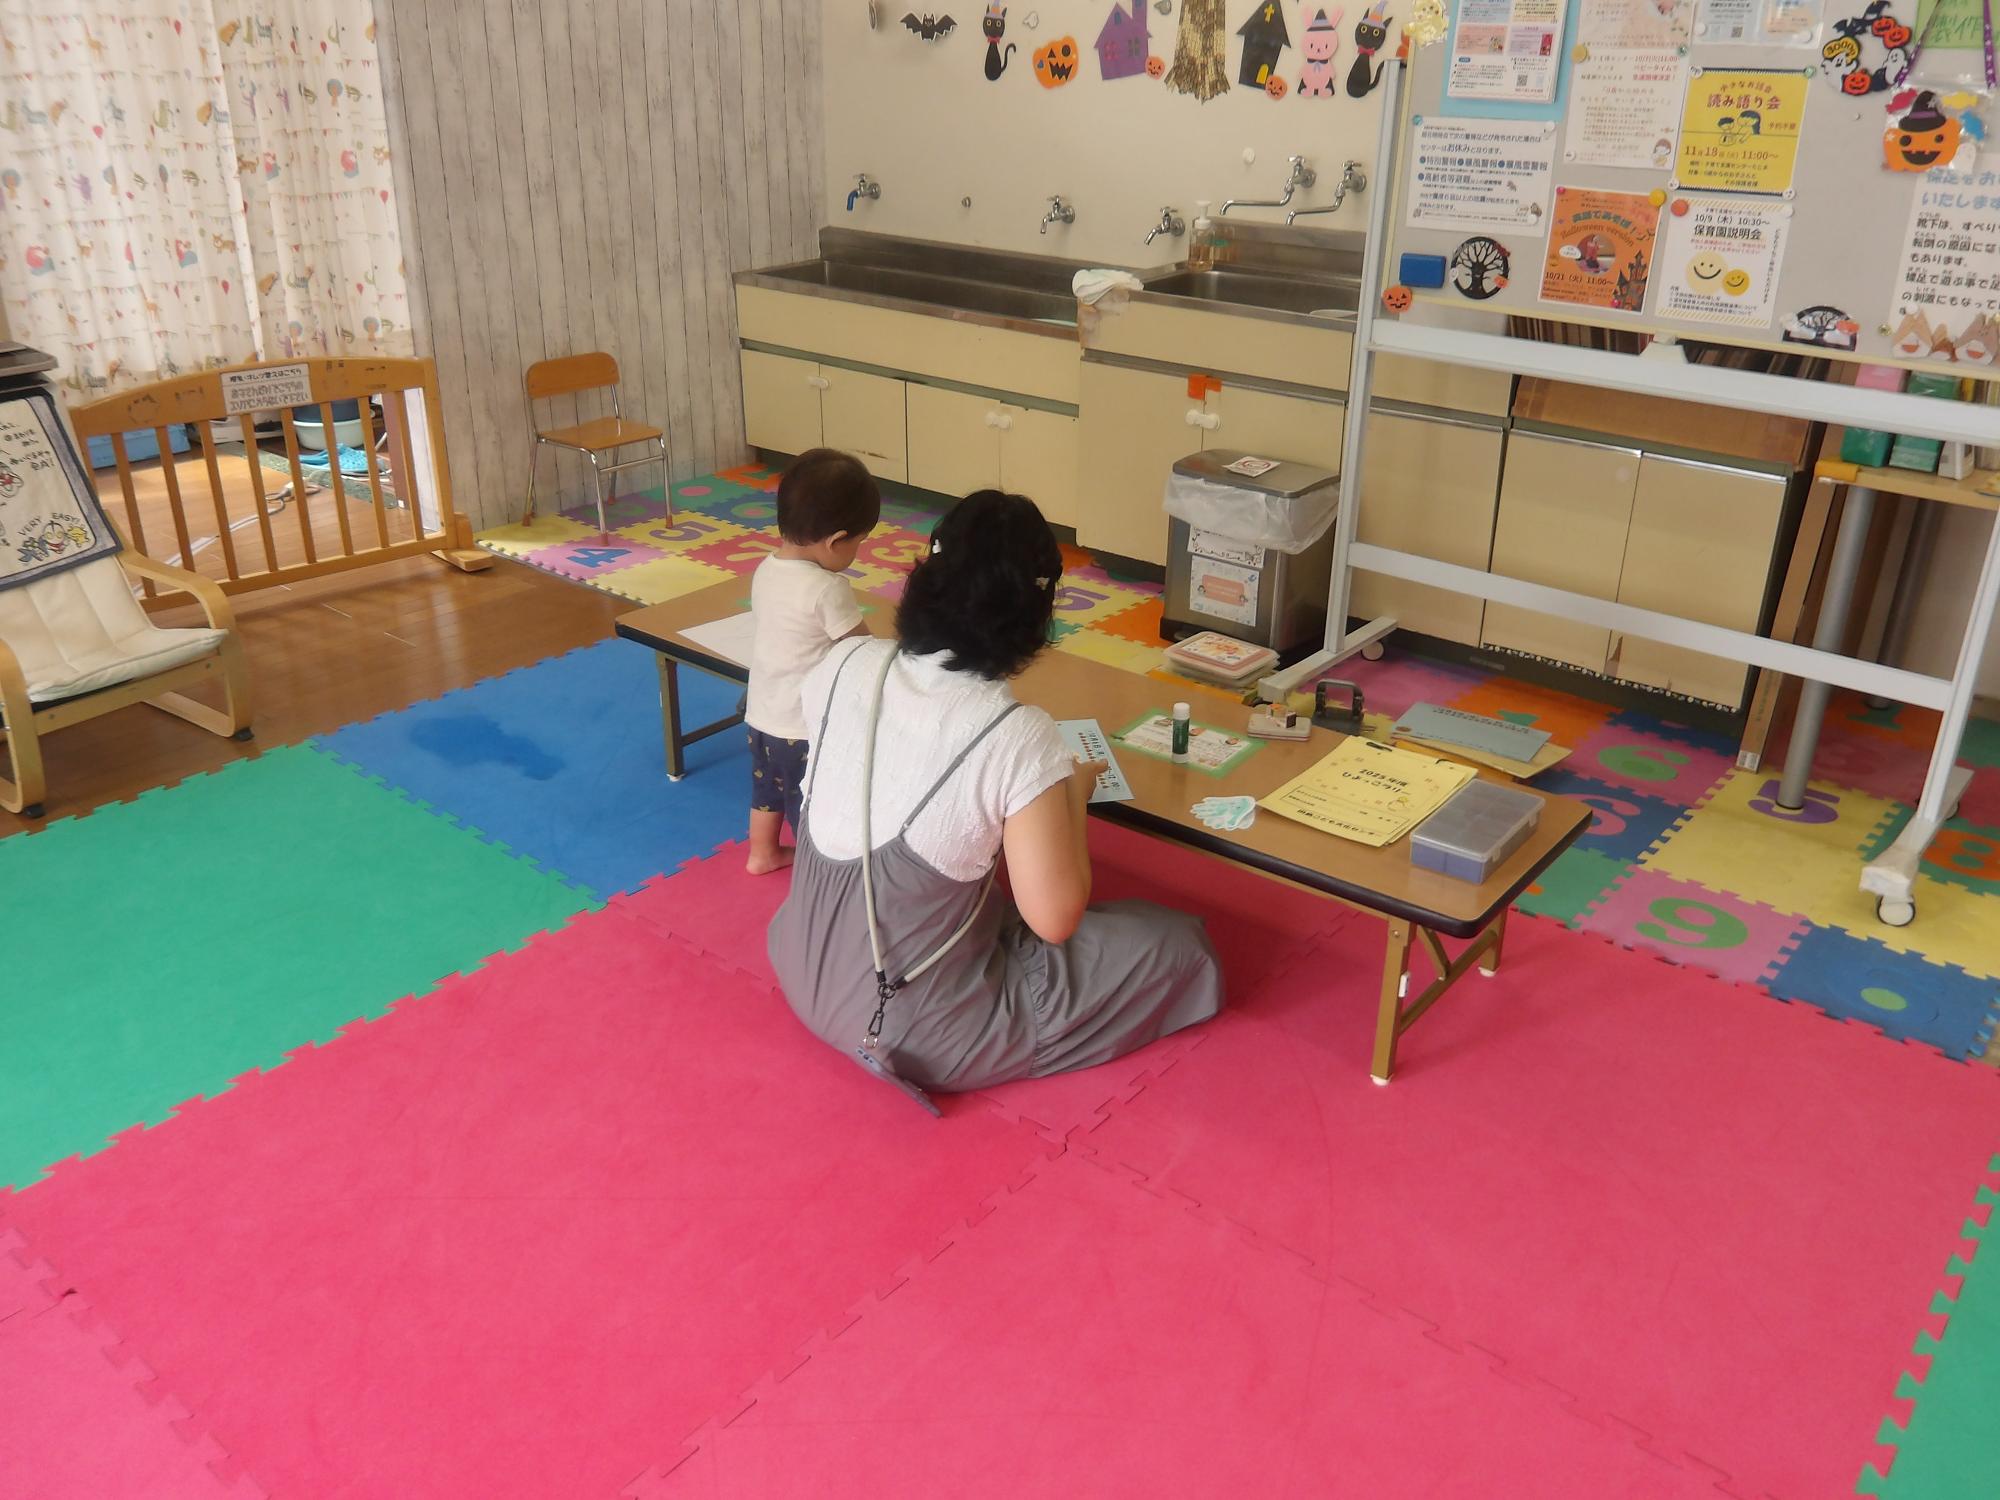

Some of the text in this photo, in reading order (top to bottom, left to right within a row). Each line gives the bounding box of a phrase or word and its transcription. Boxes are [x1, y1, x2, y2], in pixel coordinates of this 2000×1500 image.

[1707, 94, 1781, 110] 読み語り会
[1695, 214, 1713, 223] 10/9
[1916, 218, 2000, 233] 靴下は、すべり
[1694, 225, 1762, 240] 保育園説明会
[1912, 237, 2000, 254] 転倒の原因にな
[1910, 253, 1967, 267] もあります。
[1545, 272, 1565, 281] 10/21
[1902, 291, 2000, 310] の刺激にもなって
[17, 515, 42, 537] VERY
[566, 546, 634, 569] 4
[1635, 897, 1749, 949] 9
